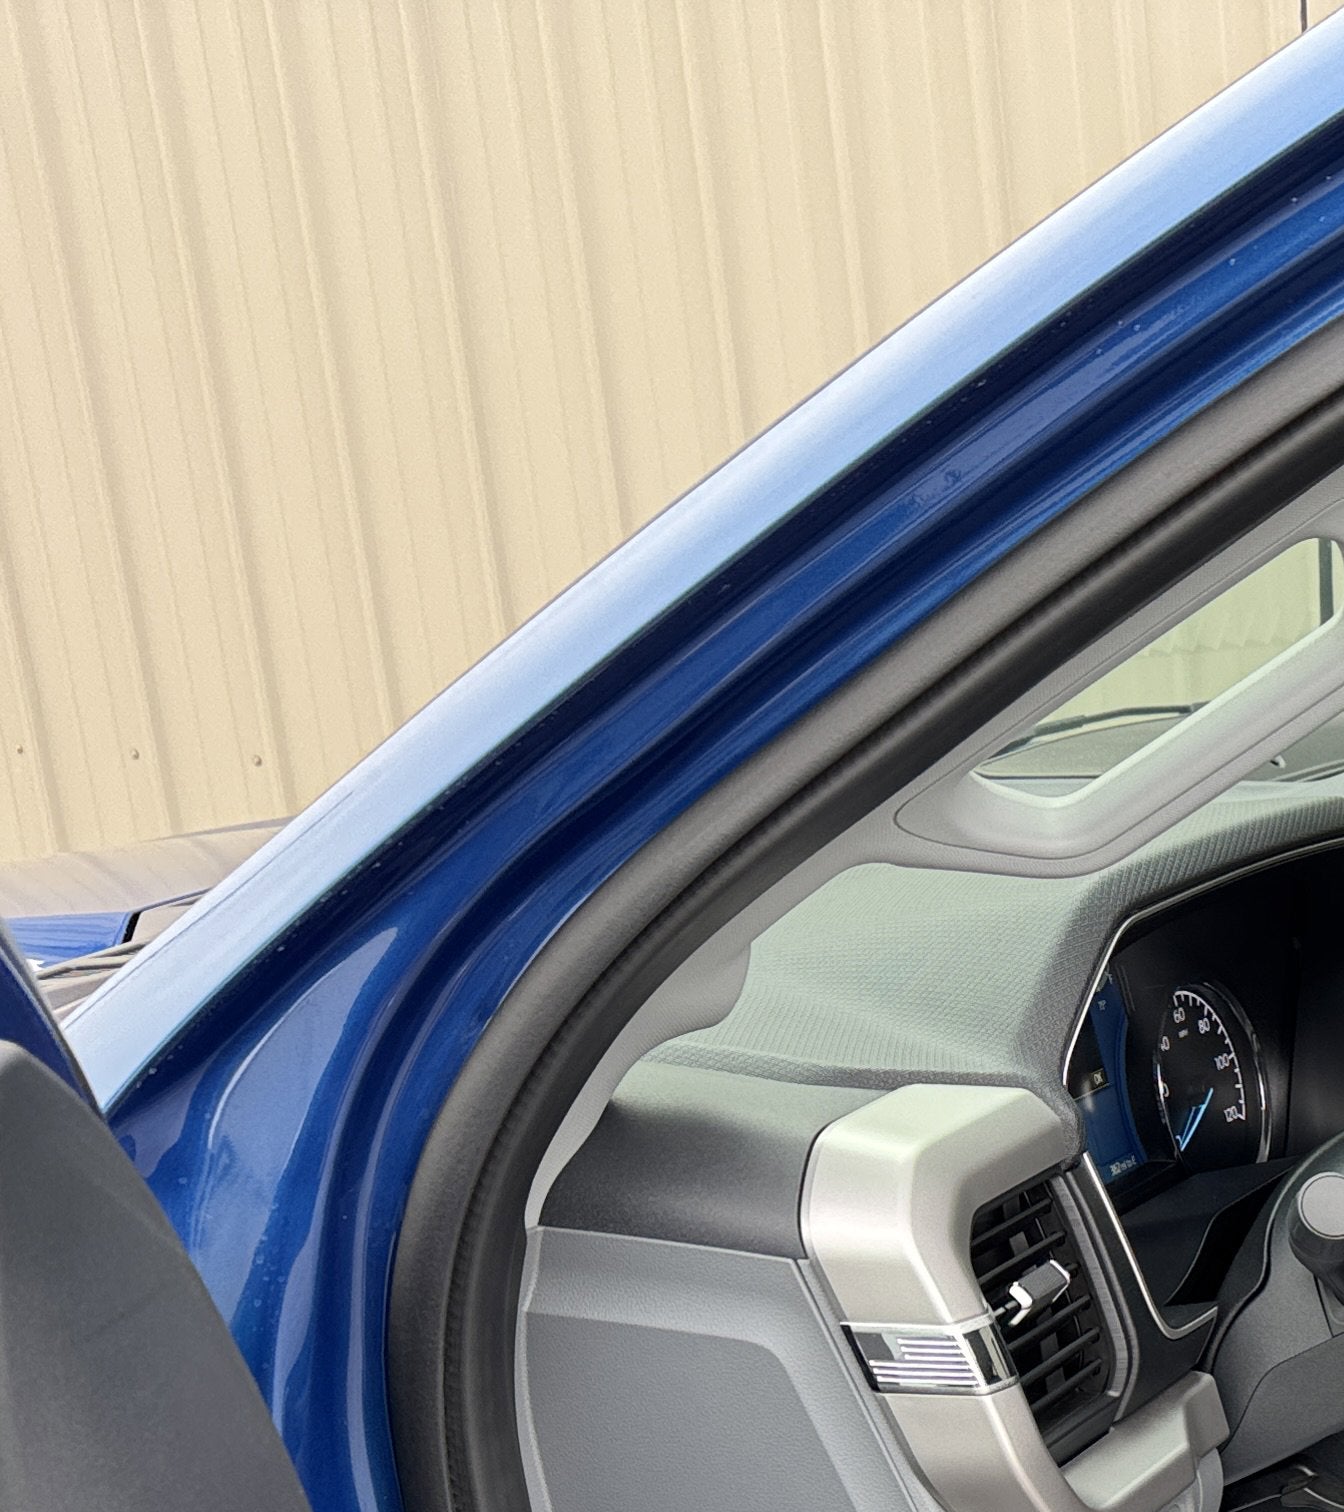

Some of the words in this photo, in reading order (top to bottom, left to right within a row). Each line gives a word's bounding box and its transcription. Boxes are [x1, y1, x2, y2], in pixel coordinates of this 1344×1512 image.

[1173, 1007, 1186, 1023] 60
[1198, 1018, 1211, 1034] 80
[1214, 1053, 1230, 1071] 100
[1223, 1106, 1239, 1122] 120
